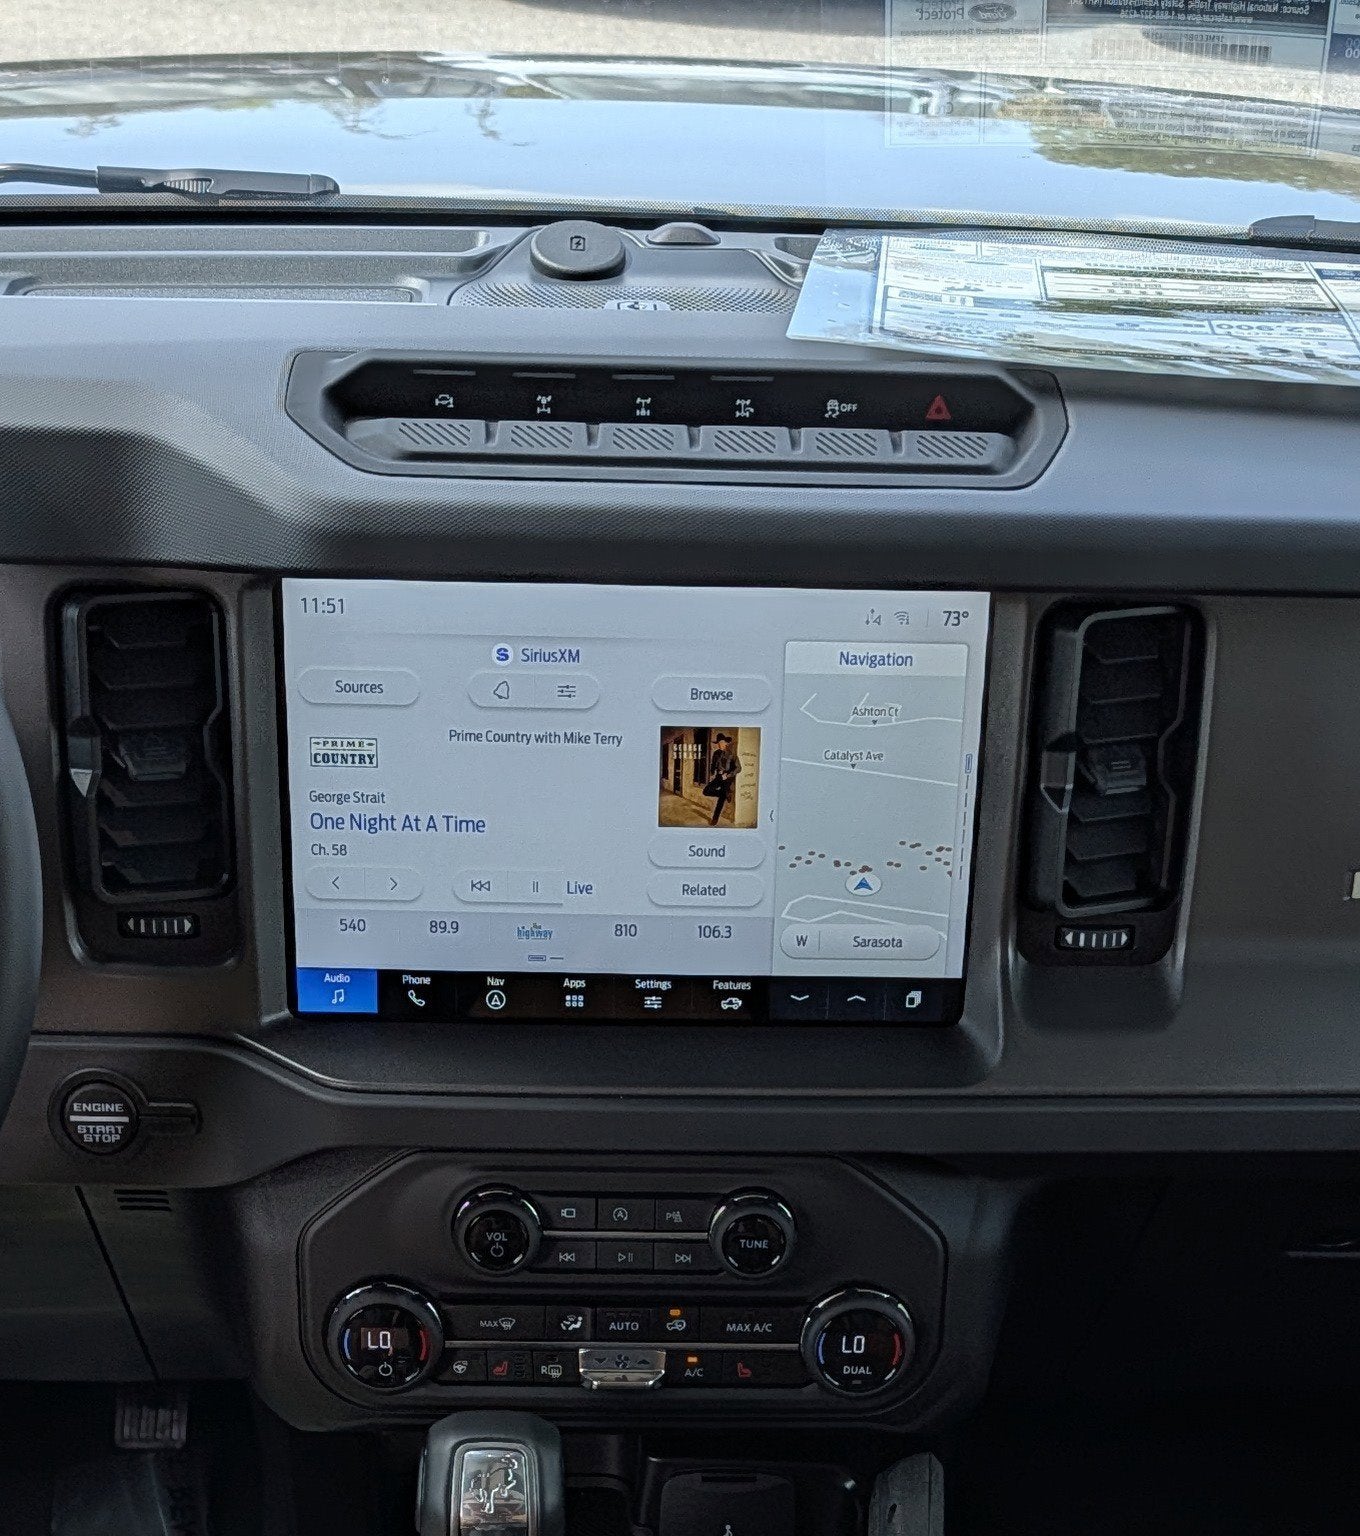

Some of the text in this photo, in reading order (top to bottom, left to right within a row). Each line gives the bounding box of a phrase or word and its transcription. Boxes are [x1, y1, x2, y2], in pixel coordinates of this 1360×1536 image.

[300, 598, 970, 628] 11:51 73°
[520, 648, 580, 664] SiriusXM
[839, 651, 914, 670] Navigation
[334, 680, 384, 695] Sources
[690, 688, 734, 702] Browse
[852, 706, 886, 718] Ashton
[322, 740, 366, 749] PRIME
[448, 730, 624, 748] Prime Country with Mike Terry
[313, 752, 376, 766] COUNTRY
[824, 749, 884, 764] Catalyst Ave
[309, 790, 386, 804] George Strait
[310, 812, 486, 836] One Night At A Time
[310, 843, 348, 857] Ch. 58
[688, 844, 726, 859] Sound
[566, 880, 594, 896] Live
[682, 884, 726, 897] Related
[340, 918, 366, 933] 540
[428, 920, 460, 935] 89.9
[614, 924, 638, 938] 810
[698, 924, 732, 940] 106.3
[516, 926, 553, 940] highway
[796, 936, 809, 948] W
[852, 936, 903, 949] Sarasota
[324, 972, 350, 984] Audio
[402, 974, 432, 986] Phone
[487, 976, 505, 988] Nav
[563, 977, 586, 990] Apps
[635, 978, 672, 991] Settings
[713, 980, 752, 991] Features
[73, 1102, 124, 1114] ENGINE
[77, 1124, 124, 1135] START
[82, 1134, 121, 1144] STOP
[486, 1232, 508, 1242] VOL
[740, 1238, 770, 1250] TUNE
[608, 1321, 640, 1332] AUTO
[726, 1322, 773, 1333] MAX A/C
[366, 1330, 392, 1350] LO
[841, 1335, 866, 1355] LO
[684, 1367, 704, 1378] A/C
[842, 1365, 872, 1376] DUAL
